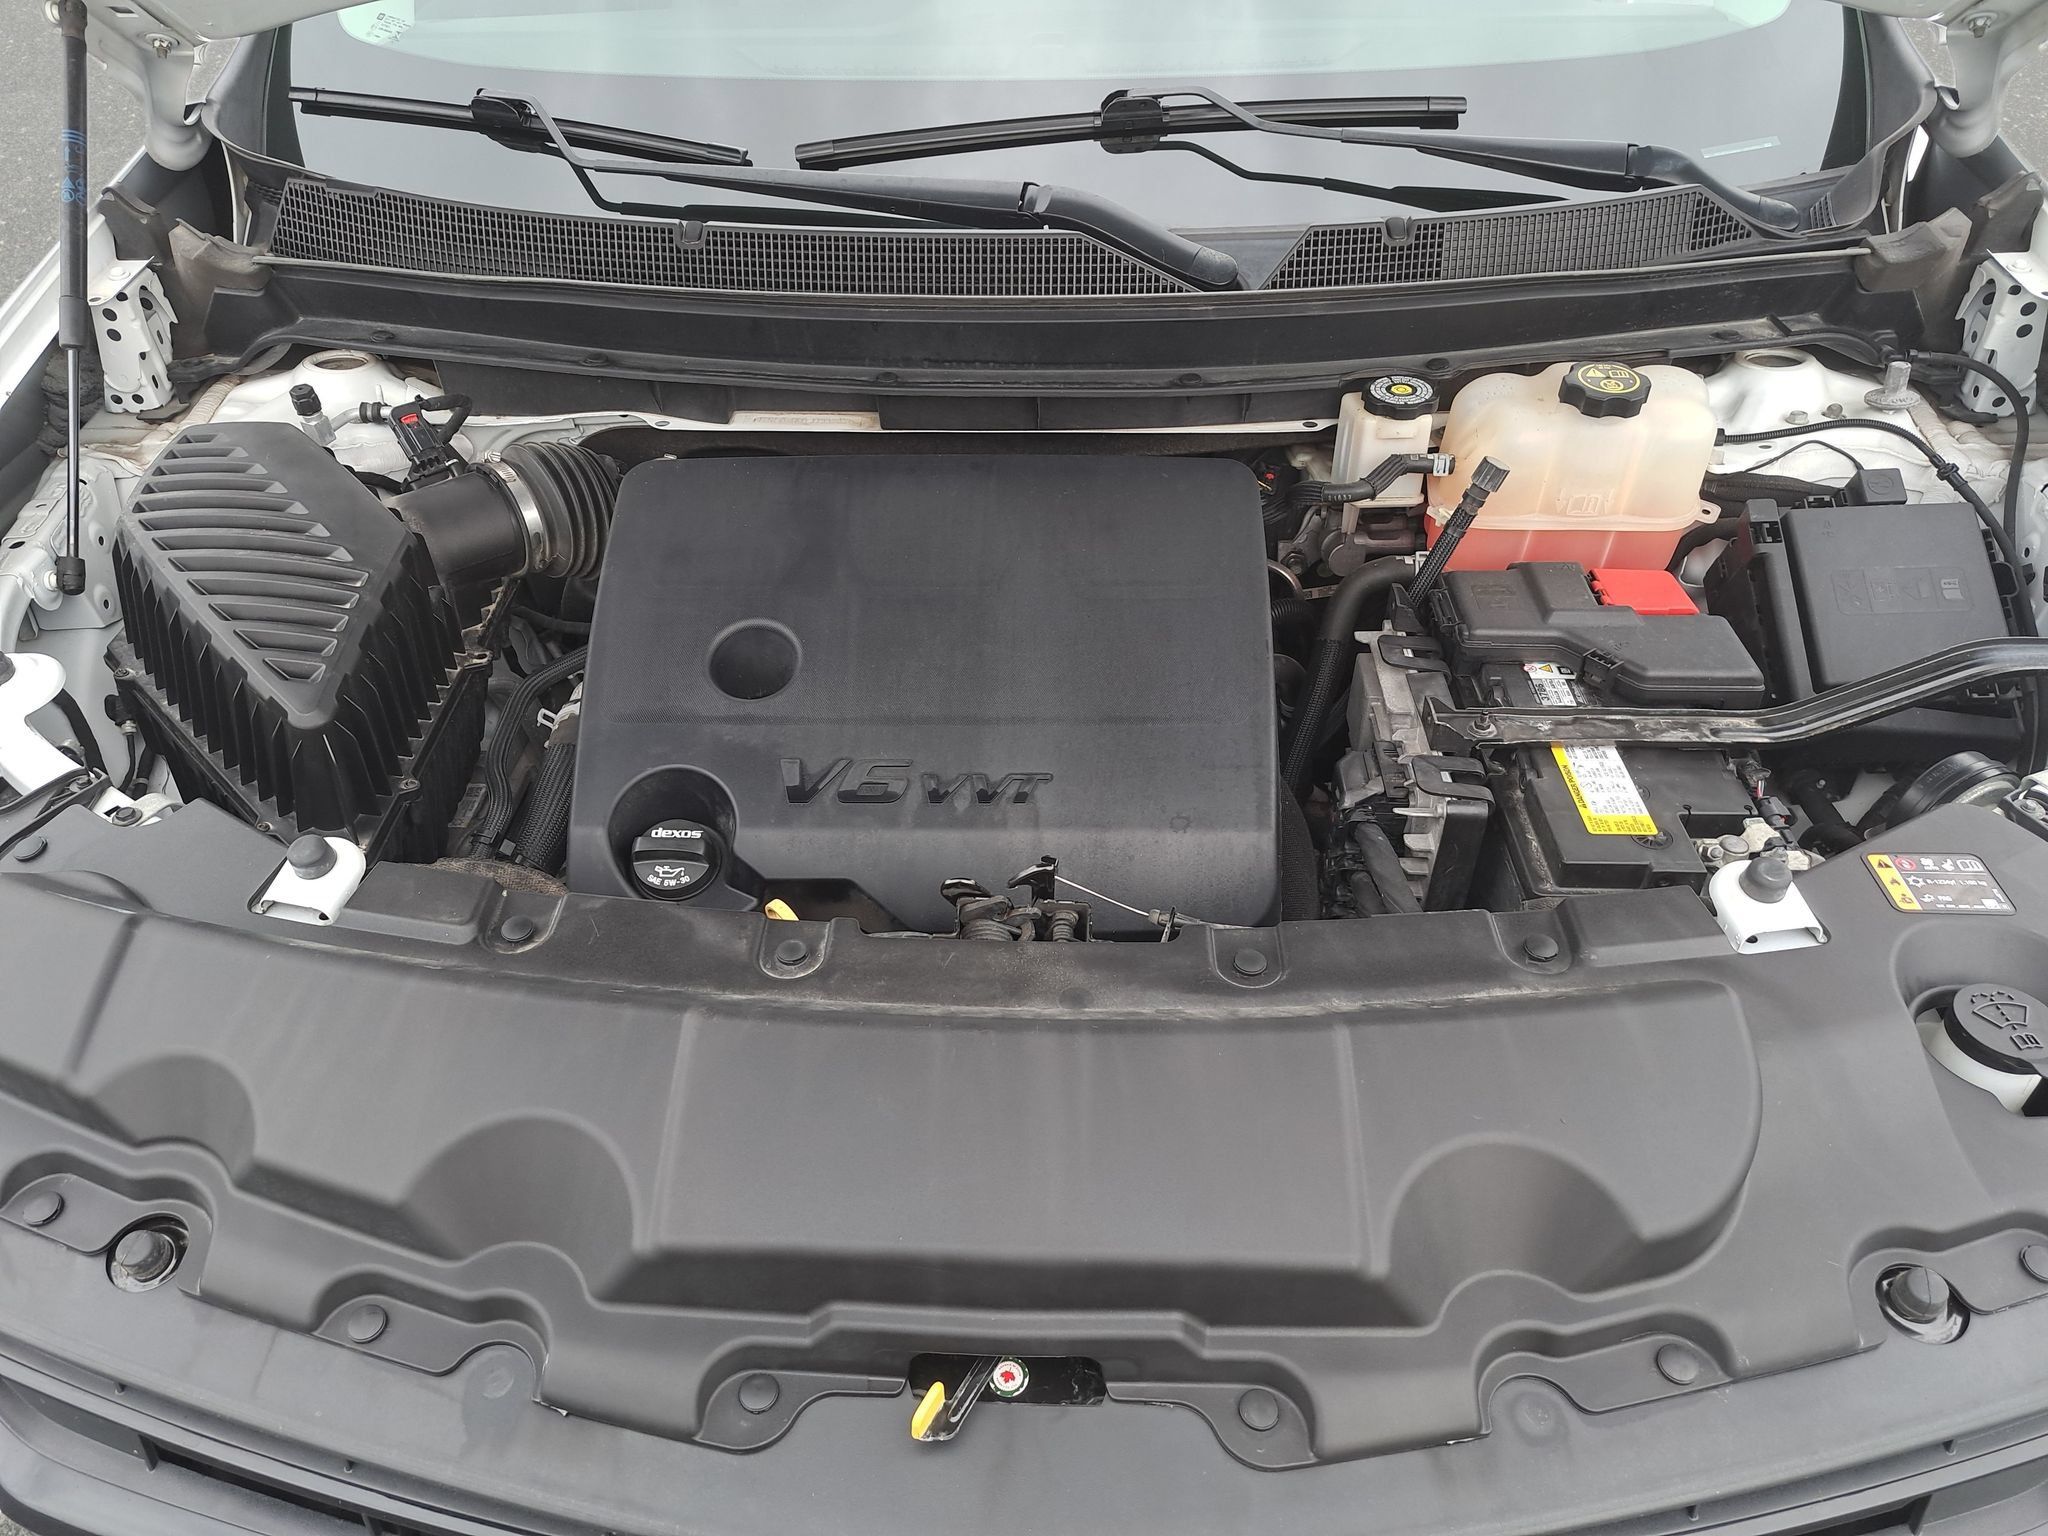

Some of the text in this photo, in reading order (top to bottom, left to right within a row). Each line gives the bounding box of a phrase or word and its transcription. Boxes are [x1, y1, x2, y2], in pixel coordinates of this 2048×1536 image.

[779, 758, 1054, 804] V6 VVT
[1561, 764, 1585, 803] DANGER POISON
[651, 828, 703, 838] dexos
[647, 874, 690, 886] SAE 5W-30
